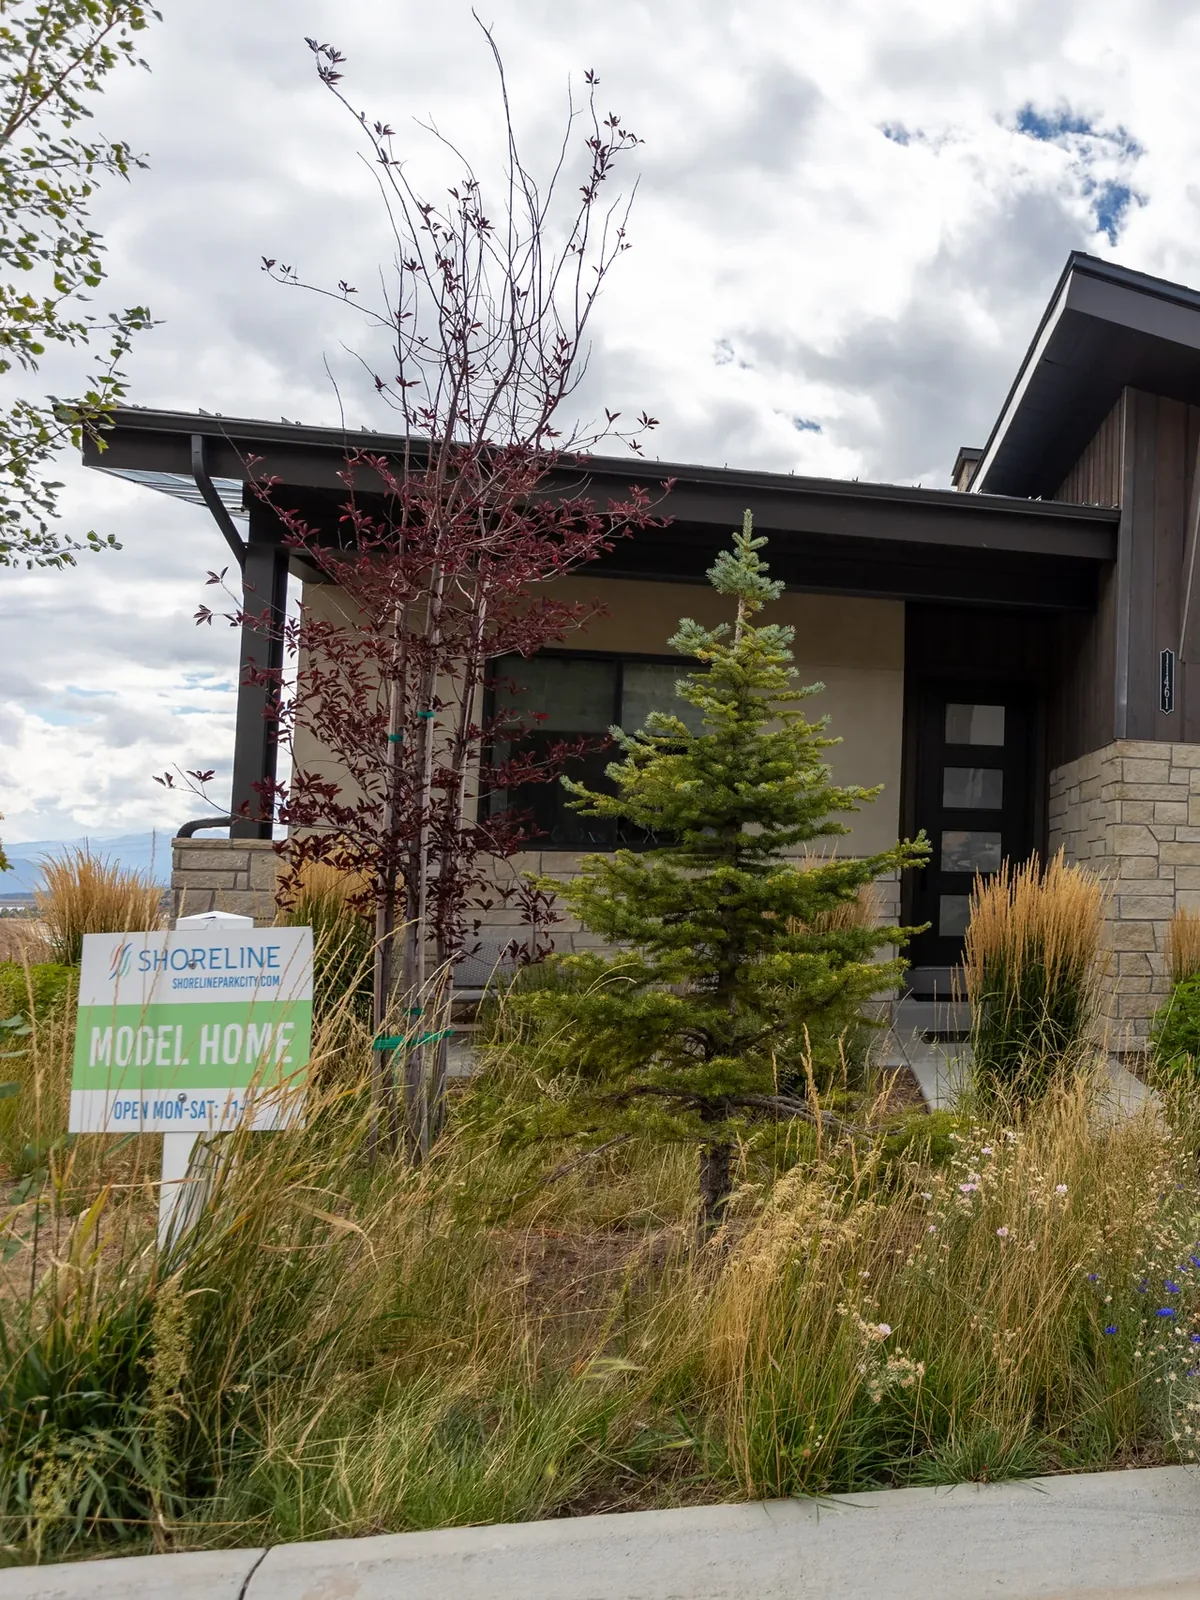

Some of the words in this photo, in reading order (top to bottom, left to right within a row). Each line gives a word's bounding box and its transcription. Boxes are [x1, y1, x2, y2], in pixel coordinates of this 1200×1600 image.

[138, 946, 281, 972] SHORELINE
[172, 975, 280, 990] SHORELINEPARKCITYCOM
[89, 1024, 189, 1067] MODEL
[200, 1022, 295, 1065] HOME
[114, 1100, 148, 1120] OPEN
